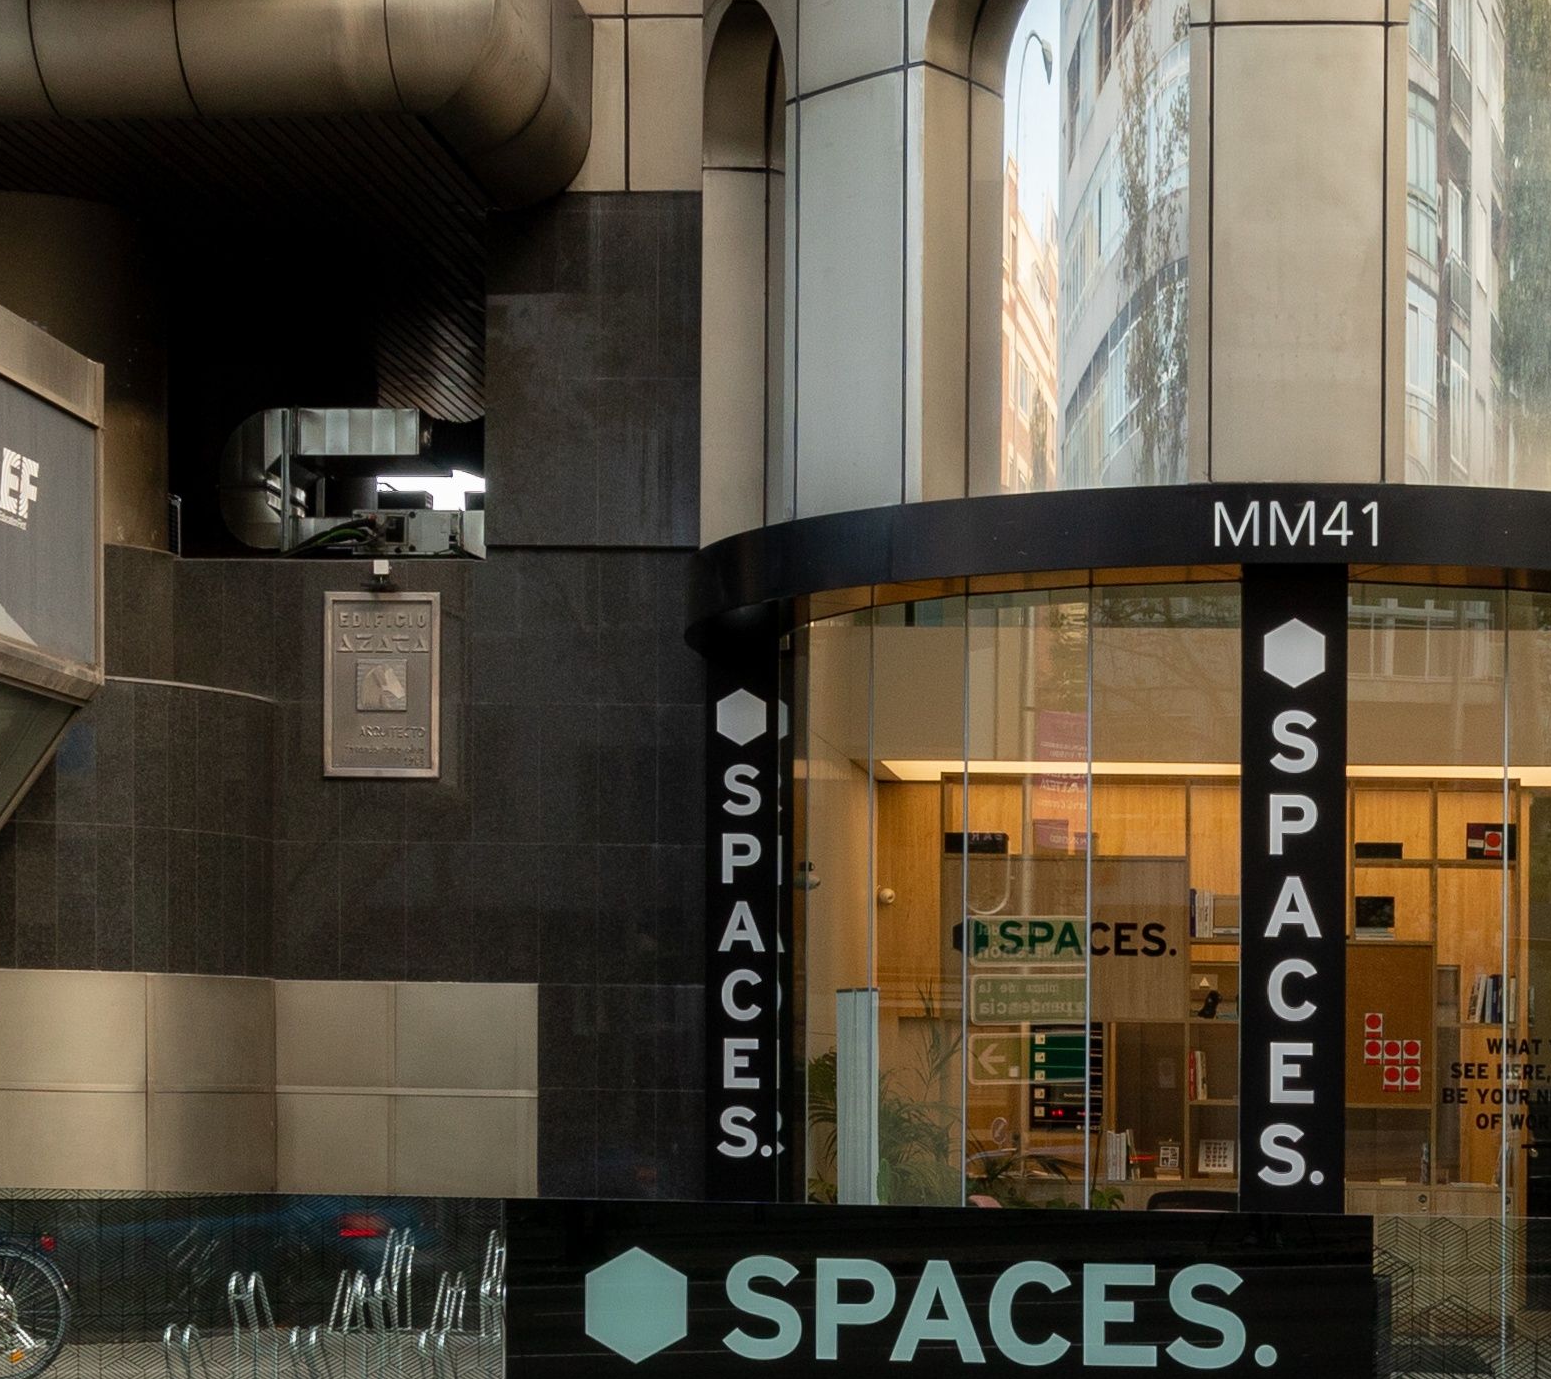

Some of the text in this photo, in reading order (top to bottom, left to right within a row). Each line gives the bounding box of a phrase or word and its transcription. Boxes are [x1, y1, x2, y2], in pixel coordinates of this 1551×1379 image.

[0, 447, 39, 519] EF
[1214, 500, 1380, 547] MM41
[338, 612, 427, 629] EDIFICIO
[999, 920, 1178, 958] SPACES.
[1257, 709, 1325, 1187] SPACES.
[716, 763, 772, 1158] SPACES.
[1486, 1038, 1542, 1055] WHAT
[1451, 1062, 1489, 1079] SEE
[1442, 1088, 1468, 1104] BE
[1476, 1088, 1530, 1105] YOUR
[1475, 1113, 1502, 1130] OF
[722, 1254, 1279, 1369] SPACES.
